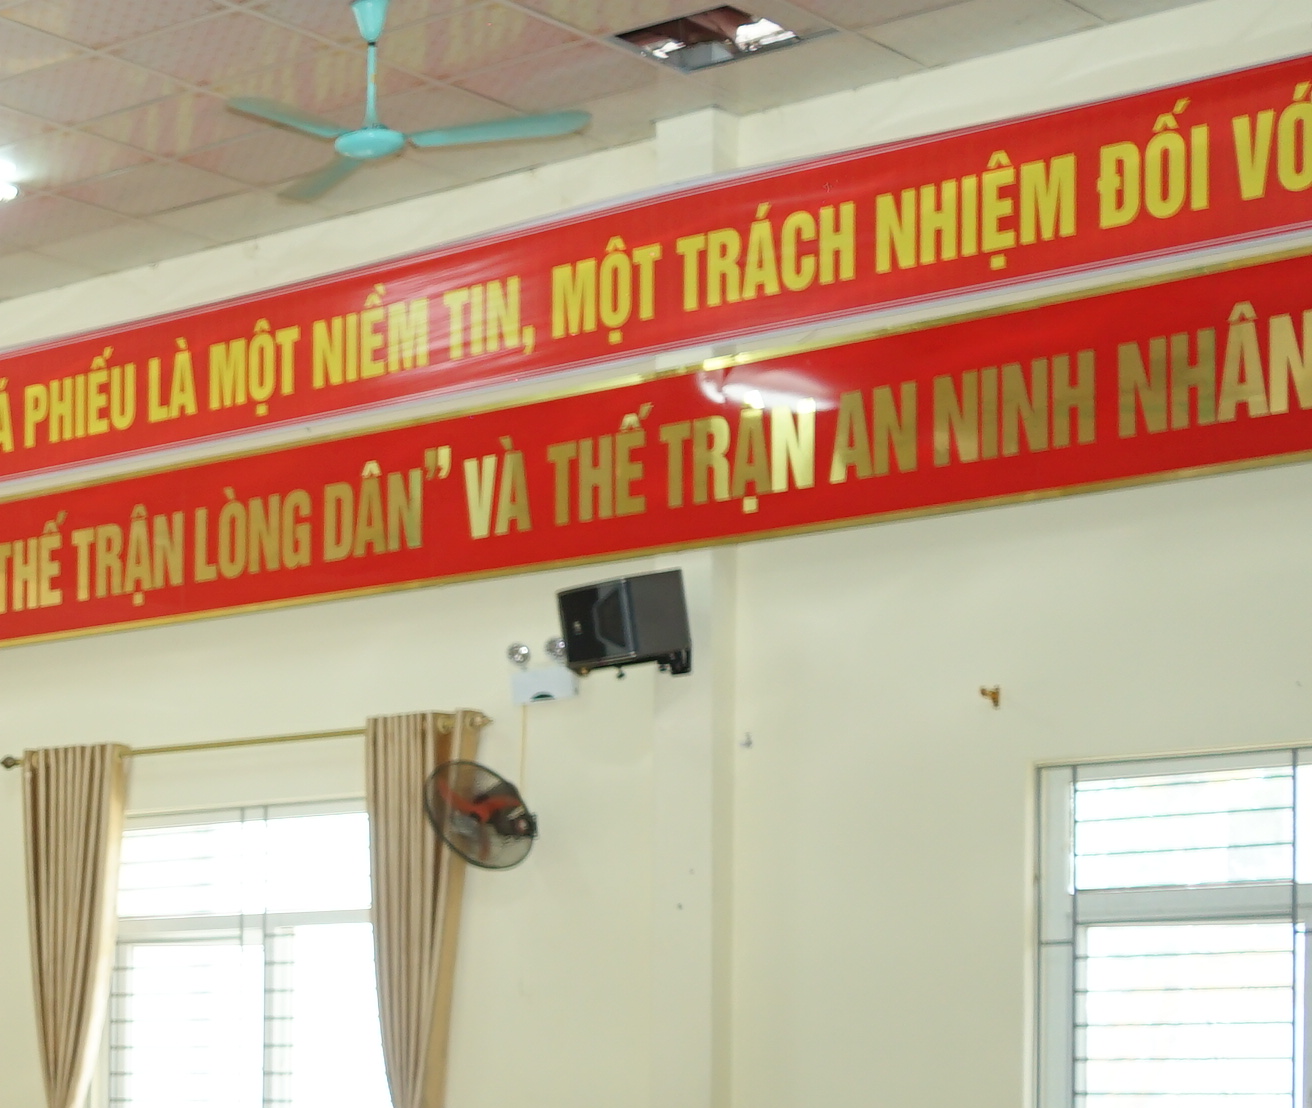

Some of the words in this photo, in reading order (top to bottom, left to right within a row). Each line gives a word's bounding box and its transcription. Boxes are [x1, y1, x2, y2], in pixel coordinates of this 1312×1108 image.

[24, 346, 136, 448] PHIẾU
[147, 337, 197, 423] LÀ
[208, 318, 301, 417] MỘT
[311, 282, 430, 389] NIỀM
[443, 275, 536, 360] TIN,
[551, 235, 663, 345] MỘT
[676, 203, 856, 313] TRÁCH
[874, 149, 1077, 270] NHIỆM
[1096, 97, 1210, 229] ĐỐI
[71, 505, 184, 606] TRẬN
[195, 487, 313, 582] LÒNG
[463, 436, 531, 539] VÀ
[546, 404, 654, 526] THẾ
[659, 396, 817, 514] TRẬN
[828, 380, 918, 484] AN
[932, 348, 1096, 466] NINH
[1117, 300, 1312, 439] NHÂN
